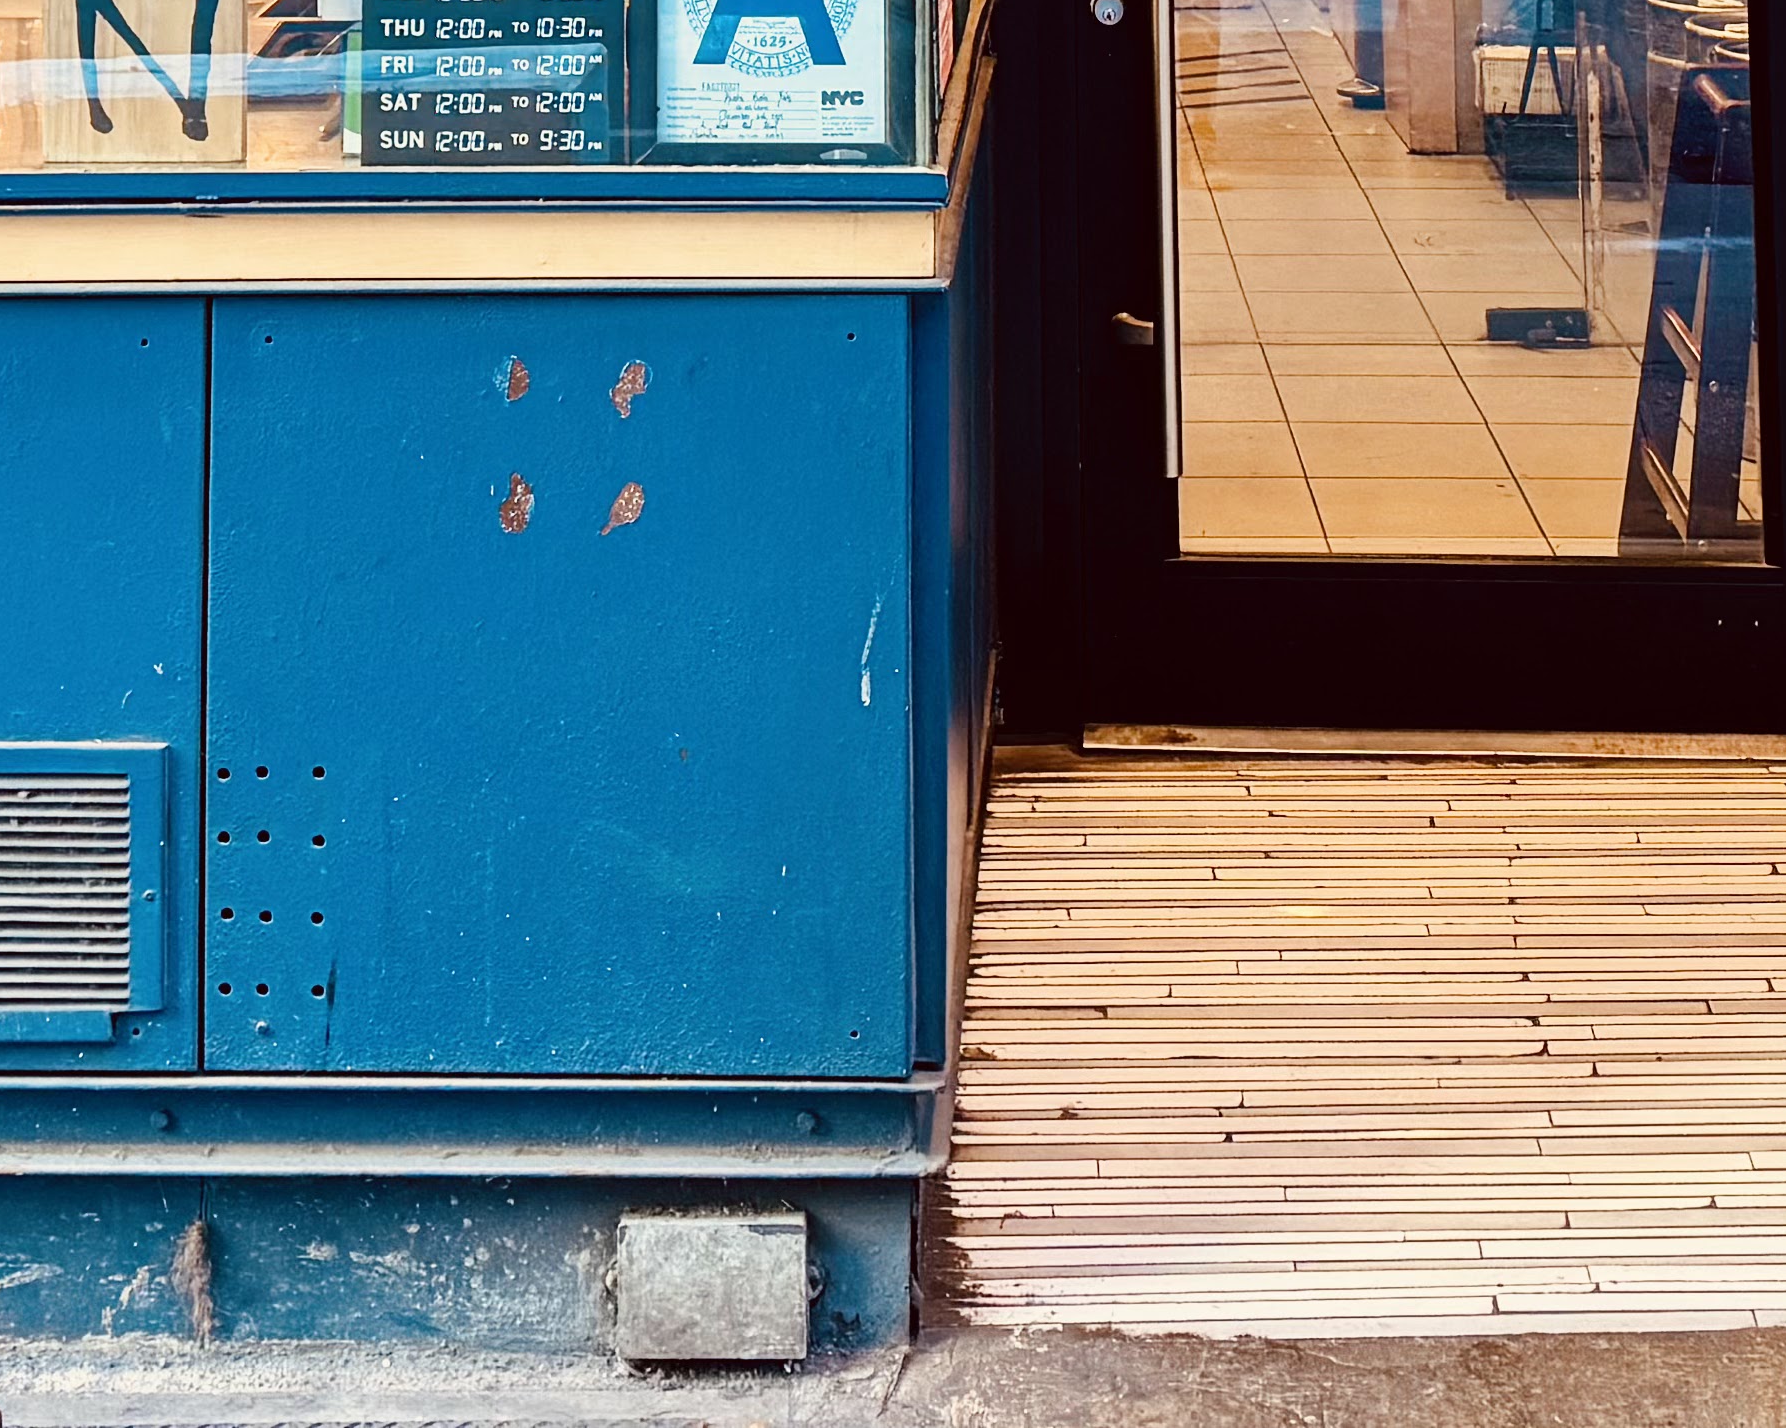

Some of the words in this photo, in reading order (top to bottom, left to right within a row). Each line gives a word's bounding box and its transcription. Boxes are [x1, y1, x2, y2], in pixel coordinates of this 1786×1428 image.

[380, 18, 425, 37] THU
[436, 18, 485, 39] 12:00
[511, 22, 529, 33] TO
[753, 35, 787, 49] 1625
[380, 55, 414, 74] FRI
[436, 55, 485, 76] 12:00
[511, 58, 529, 71] TO
[536, 55, 586, 76] 12:00
[380, 93, 422, 112] SAT
[435, 93, 485, 114] 12:00
[511, 96, 529, 108] TO
[535, 92, 585, 113] 12:00
[821, 90, 864, 106] NYC
[380, 130, 425, 149] SUN
[435, 130, 485, 152] 12:00
[511, 133, 529, 145] TO
[539, 129, 585, 151] 9:30
